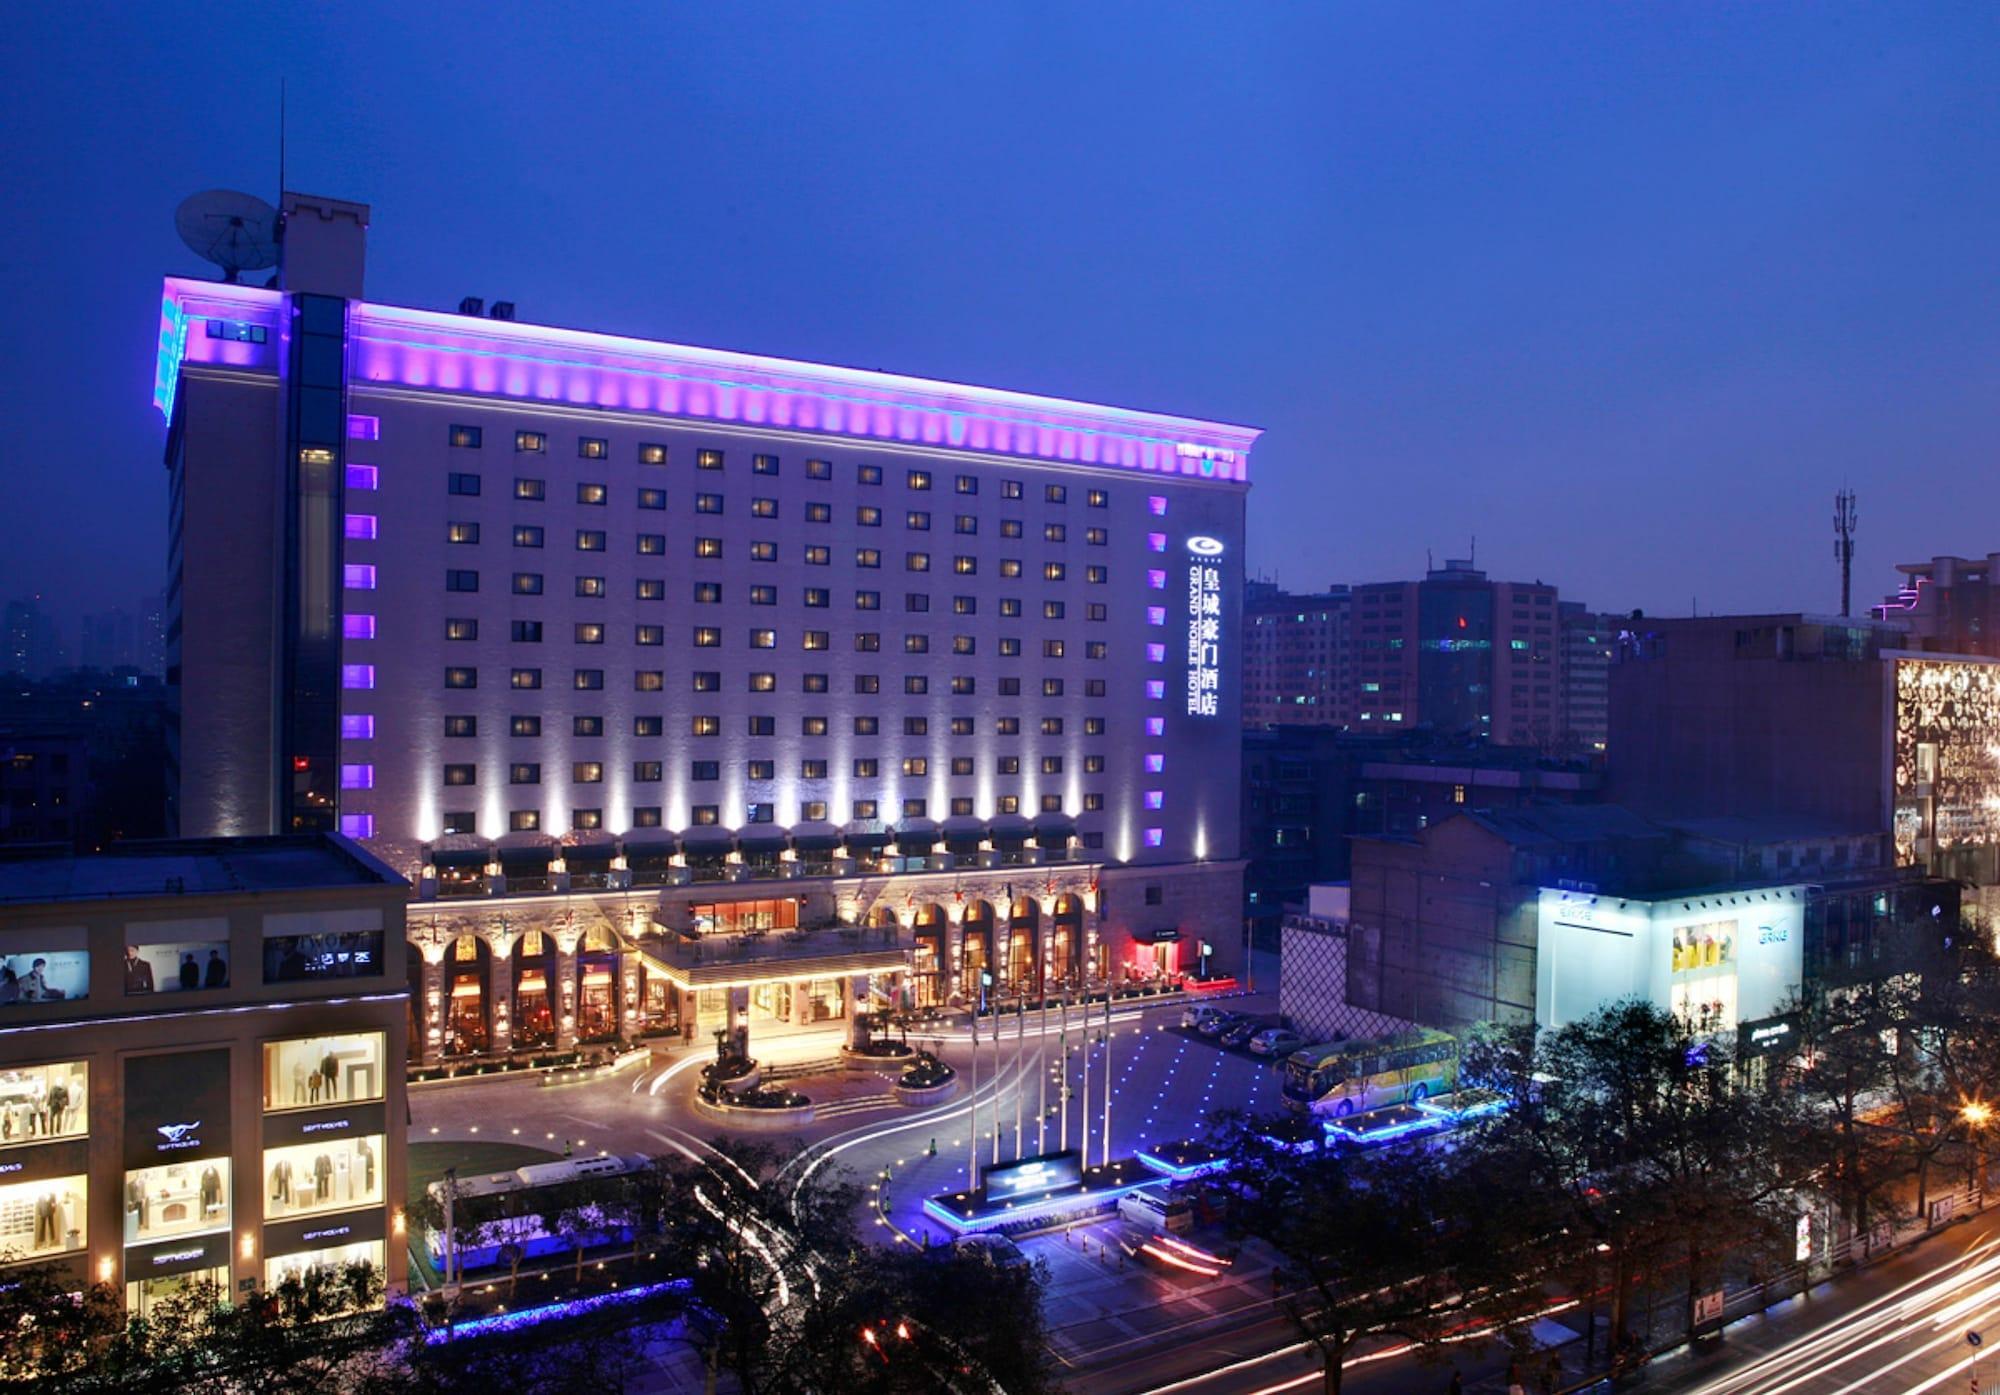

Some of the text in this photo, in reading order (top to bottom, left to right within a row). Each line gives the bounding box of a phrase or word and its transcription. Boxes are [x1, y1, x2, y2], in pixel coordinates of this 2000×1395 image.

[1187, 566, 1200, 715] GRAND NOBLE HOTEL
[1201, 568, 1220, 716] 皇城豪门酒店
